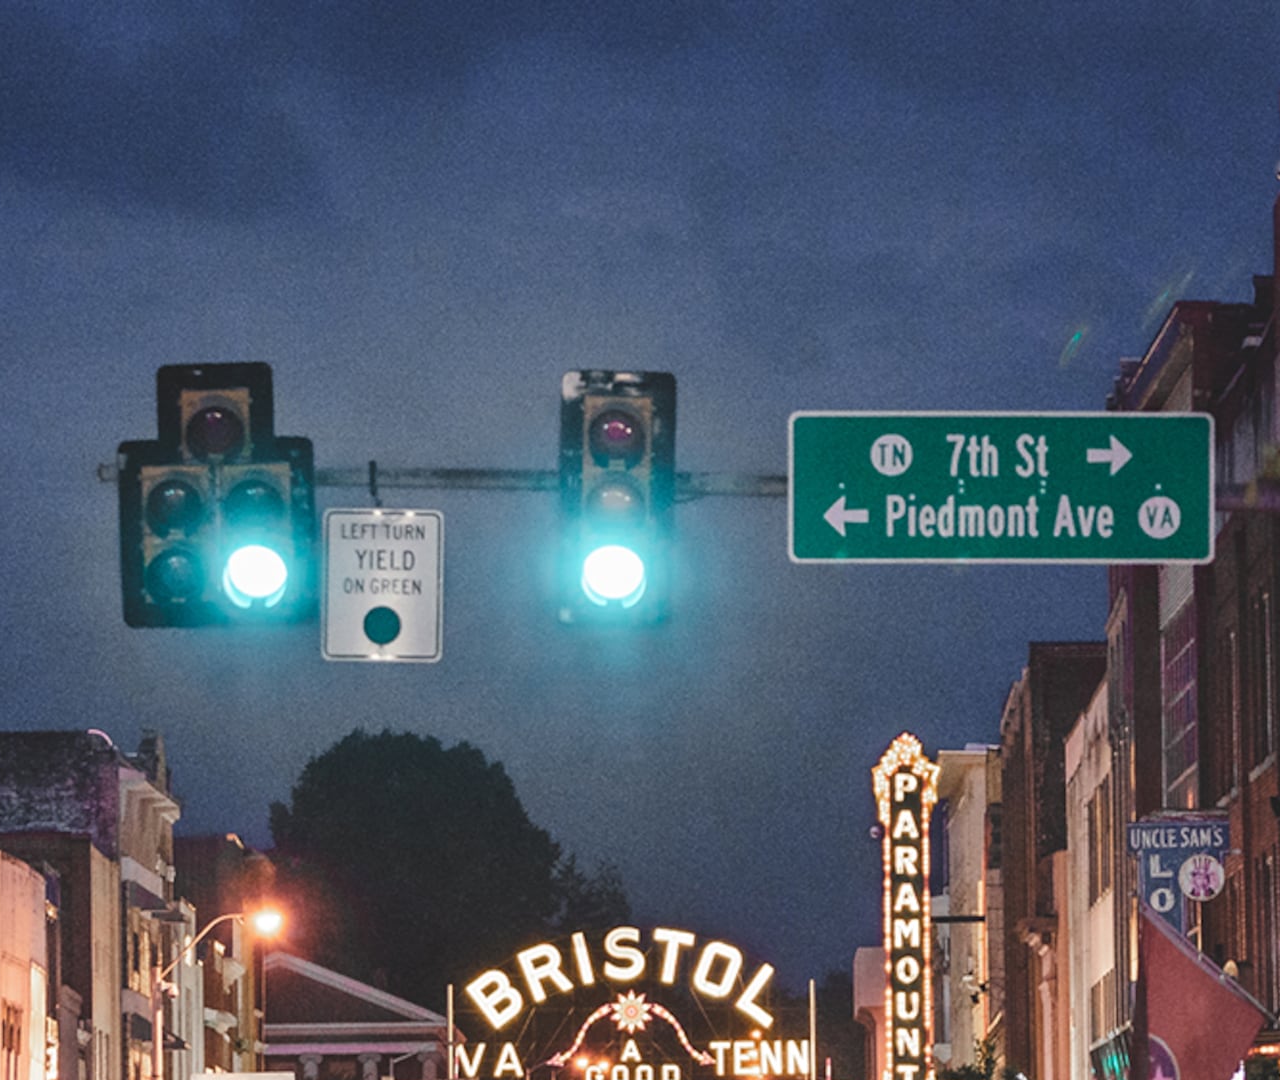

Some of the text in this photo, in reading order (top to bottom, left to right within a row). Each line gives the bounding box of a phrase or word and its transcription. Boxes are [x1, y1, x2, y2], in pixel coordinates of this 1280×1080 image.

[878, 433, 1049, 478] TN 7th St
[340, 523, 426, 540] LEFT TURN
[885, 494, 1175, 538] Piedmont Ave VA
[354, 549, 416, 571] YIELD
[343, 577, 423, 595] ON GREEN
[1130, 824, 1223, 849] UNCLE SAM'S
[465, 925, 775, 1031] BRISTOL
[455, 1041, 525, 1078] VA
[620, 1038, 642, 1063] A
[708, 1039, 810, 1077] TENN
